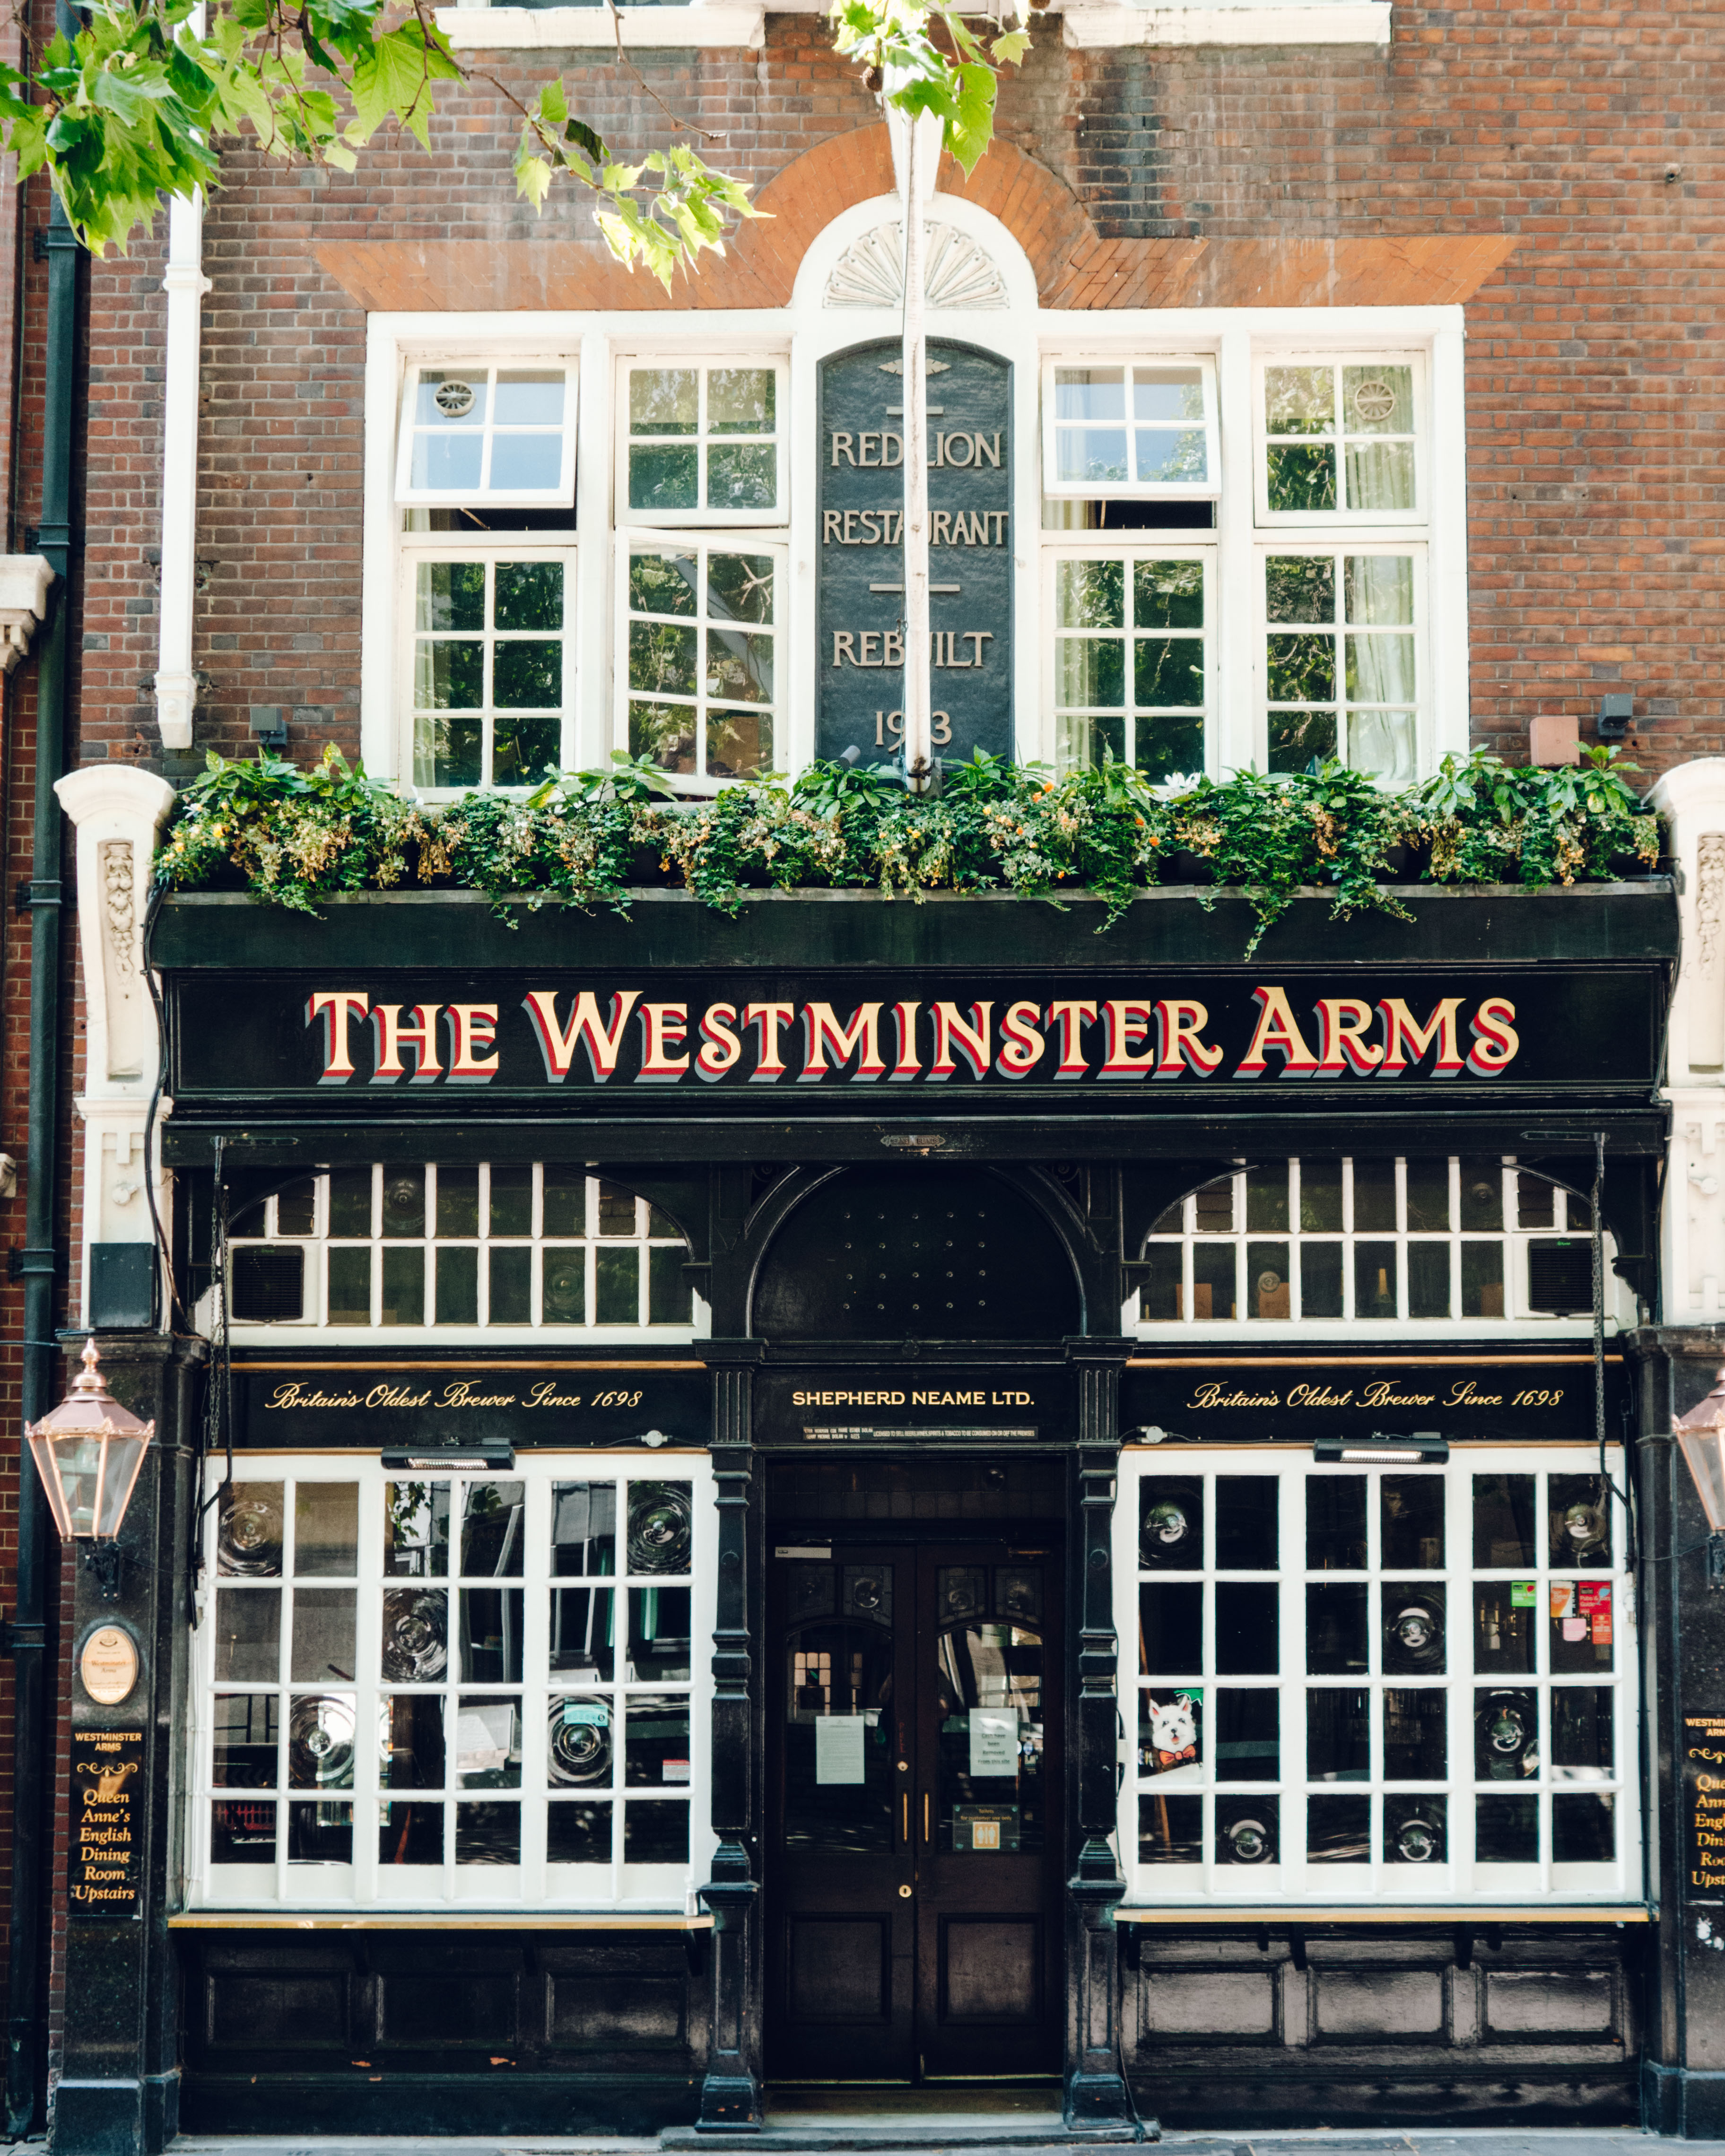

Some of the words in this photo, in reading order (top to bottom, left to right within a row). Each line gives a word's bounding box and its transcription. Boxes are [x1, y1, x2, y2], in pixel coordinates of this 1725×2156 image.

[831, 432, 904, 466] RED
[823, 510, 1009, 545] RESTARANT
[832, 631, 994, 667] REBILT
[875, 711, 952, 752] 193
[305, 992, 499, 1084] THE
[521, 991, 1223, 1083] WESTMINSTER
[1232, 987, 1519, 1078] ARMS
[265, 1382, 362, 1408] Britain's
[366, 1384, 429, 1407] Oldest
[435, 1381, 515, 1407] Brewer
[522, 1382, 581, 1407] Since
[591, 1391, 643, 1407] 1698
[793, 1391, 905, 1405] SHEPHERD
[912, 1391, 986, 1405] NEAME
[992, 1391, 1035, 1405] LTD.
[1187, 1382, 1281, 1408] Britain's
[1287, 1384, 1352, 1407] Oldest
[1356, 1381, 1435, 1407] Brewer
[1443, 1381, 1503, 1406] Since
[1511, 1390, 1564, 1406] 1698
[1685, 1718, 1725, 1727] WESTMI
[75, 1733, 141, 1741] WESTMINSTER
[95, 1742, 122, 1751] ARMS
[83, 1789, 130, 1806] Queen
[81, 1808, 131, 1822] Anne's
[79, 1827, 131, 1844] English
[81, 1846, 131, 1864] Dining
[84, 1866, 126, 1880] Room
[75, 1885, 135, 1903] Upstairs
